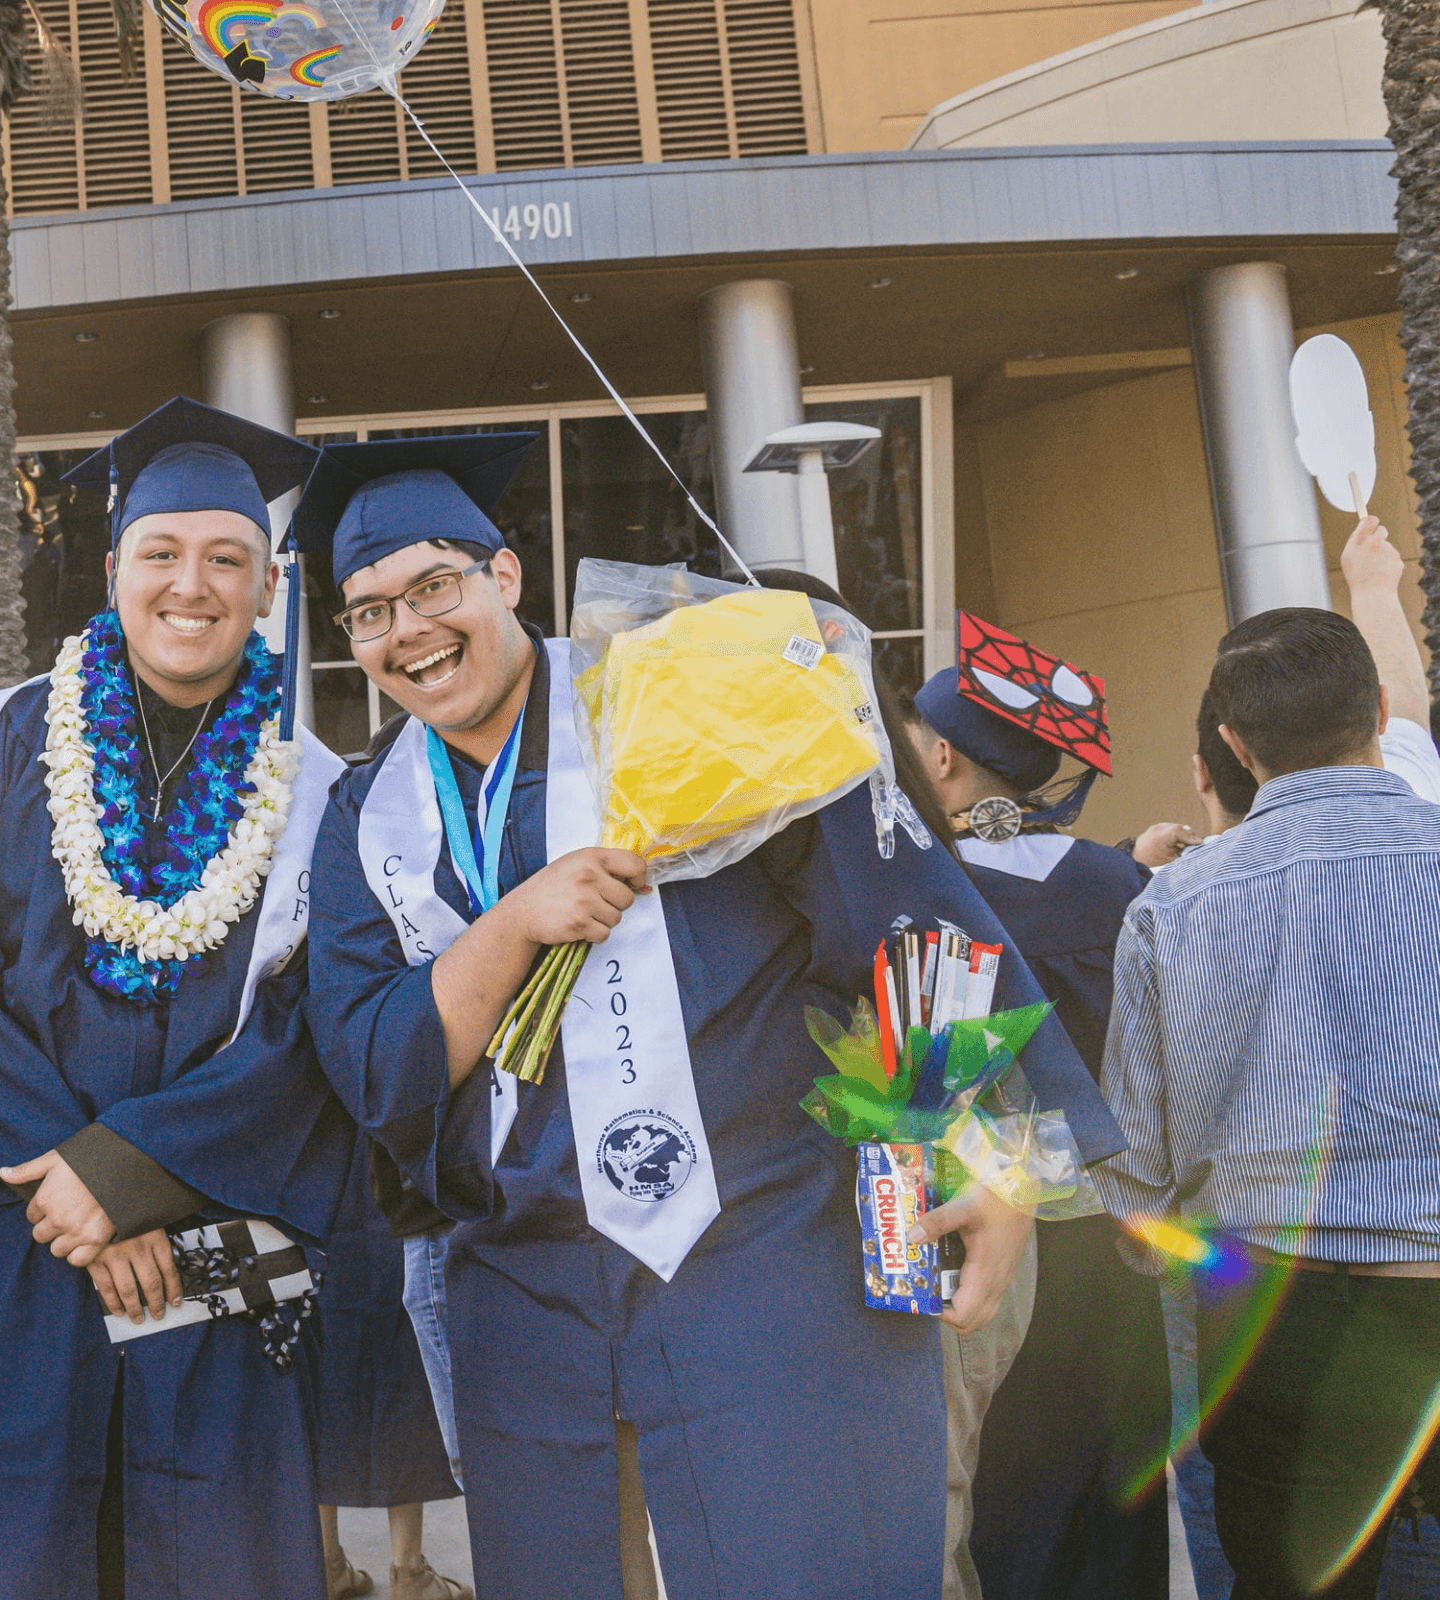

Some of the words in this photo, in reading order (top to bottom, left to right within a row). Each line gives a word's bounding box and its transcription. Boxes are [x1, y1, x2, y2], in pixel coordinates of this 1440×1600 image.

[492, 201, 573, 243] 14901
[291, 870, 311, 922] OF
[383, 854, 436, 962] CLAS
[606, 959, 637, 1084] 2023
[596, 1133, 606, 1174] Hawthorne
[604, 1109, 646, 1132] Mathematics
[657, 1110, 684, 1130] Science
[683, 1130, 698, 1165] Academy
[875, 1178, 906, 1269] CRUNCH
[900, 1192, 921, 1261] Buna
